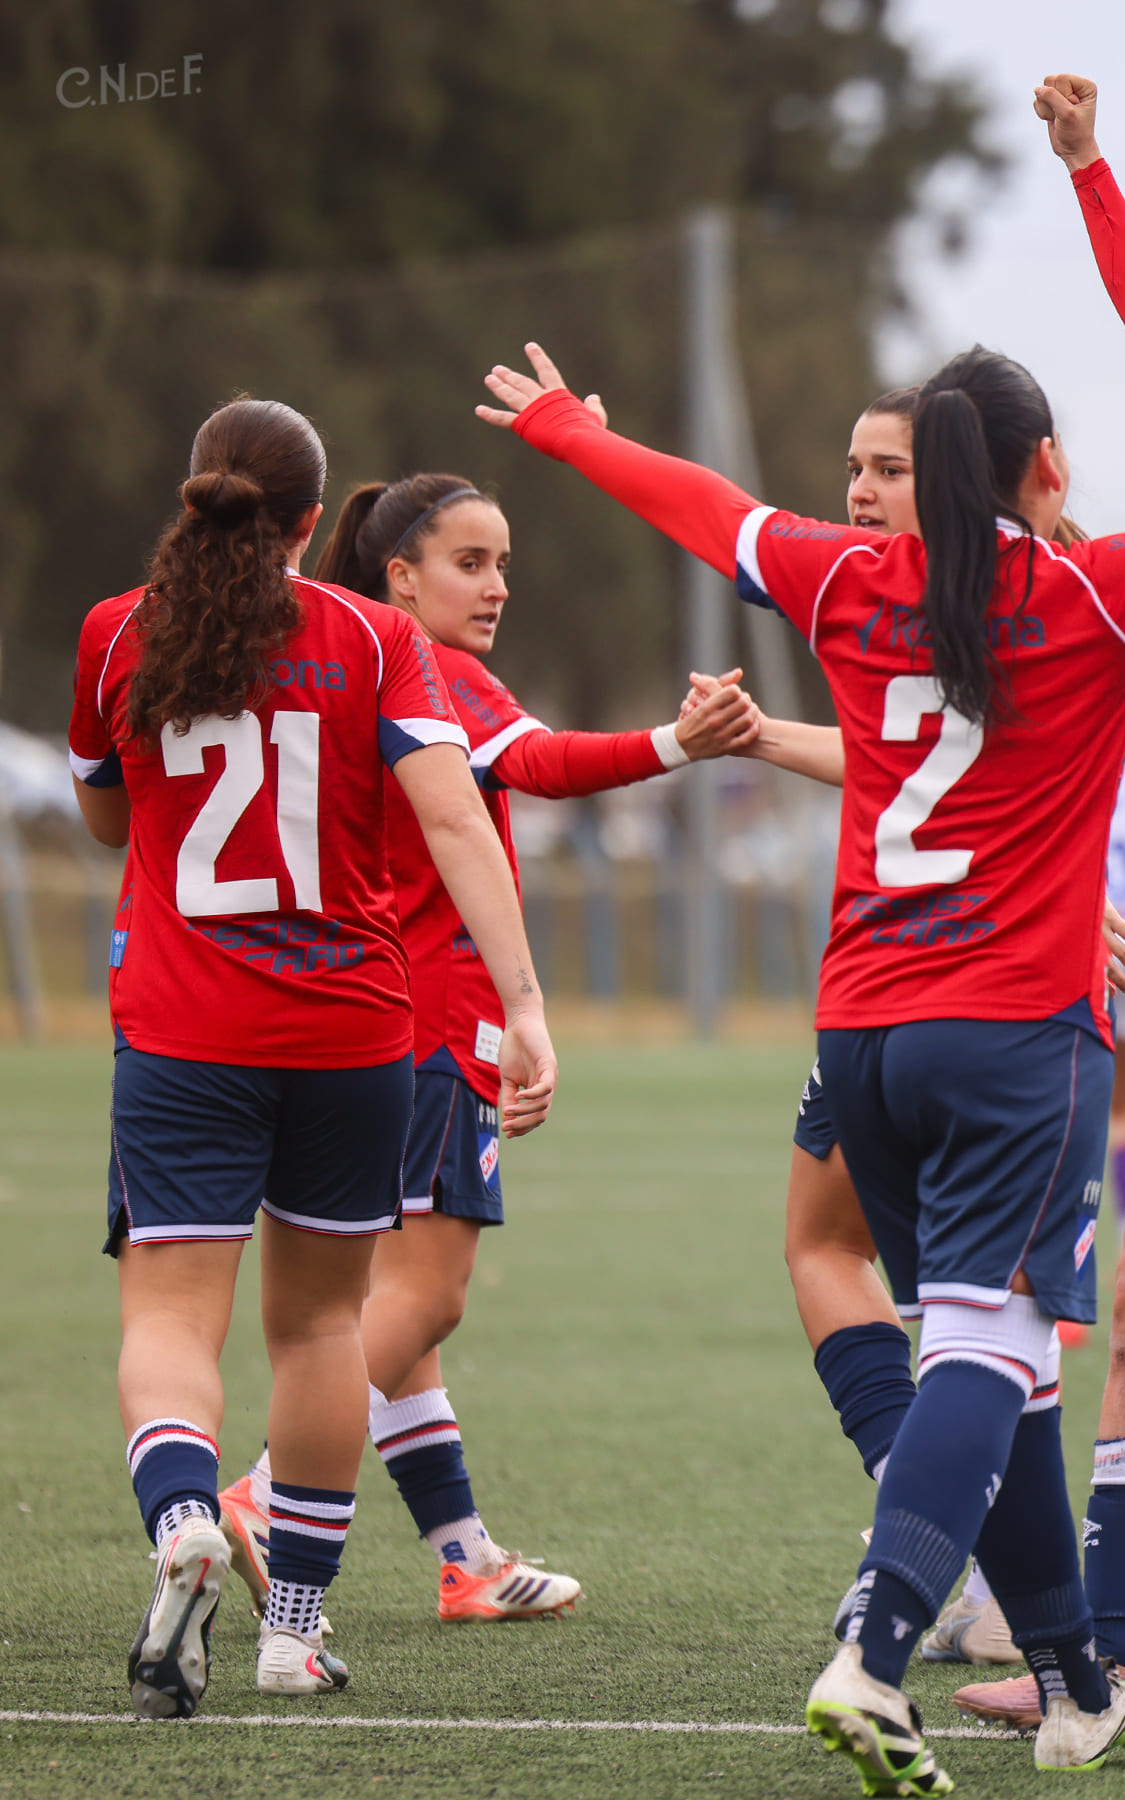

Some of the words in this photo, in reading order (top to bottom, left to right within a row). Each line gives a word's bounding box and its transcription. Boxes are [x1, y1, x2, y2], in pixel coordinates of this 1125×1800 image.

[411, 634, 447, 714] SARUBBI
[890, 604, 1046, 648] Rena
[160, 709, 324, 918] 21
[874, 675, 985, 888] 2
